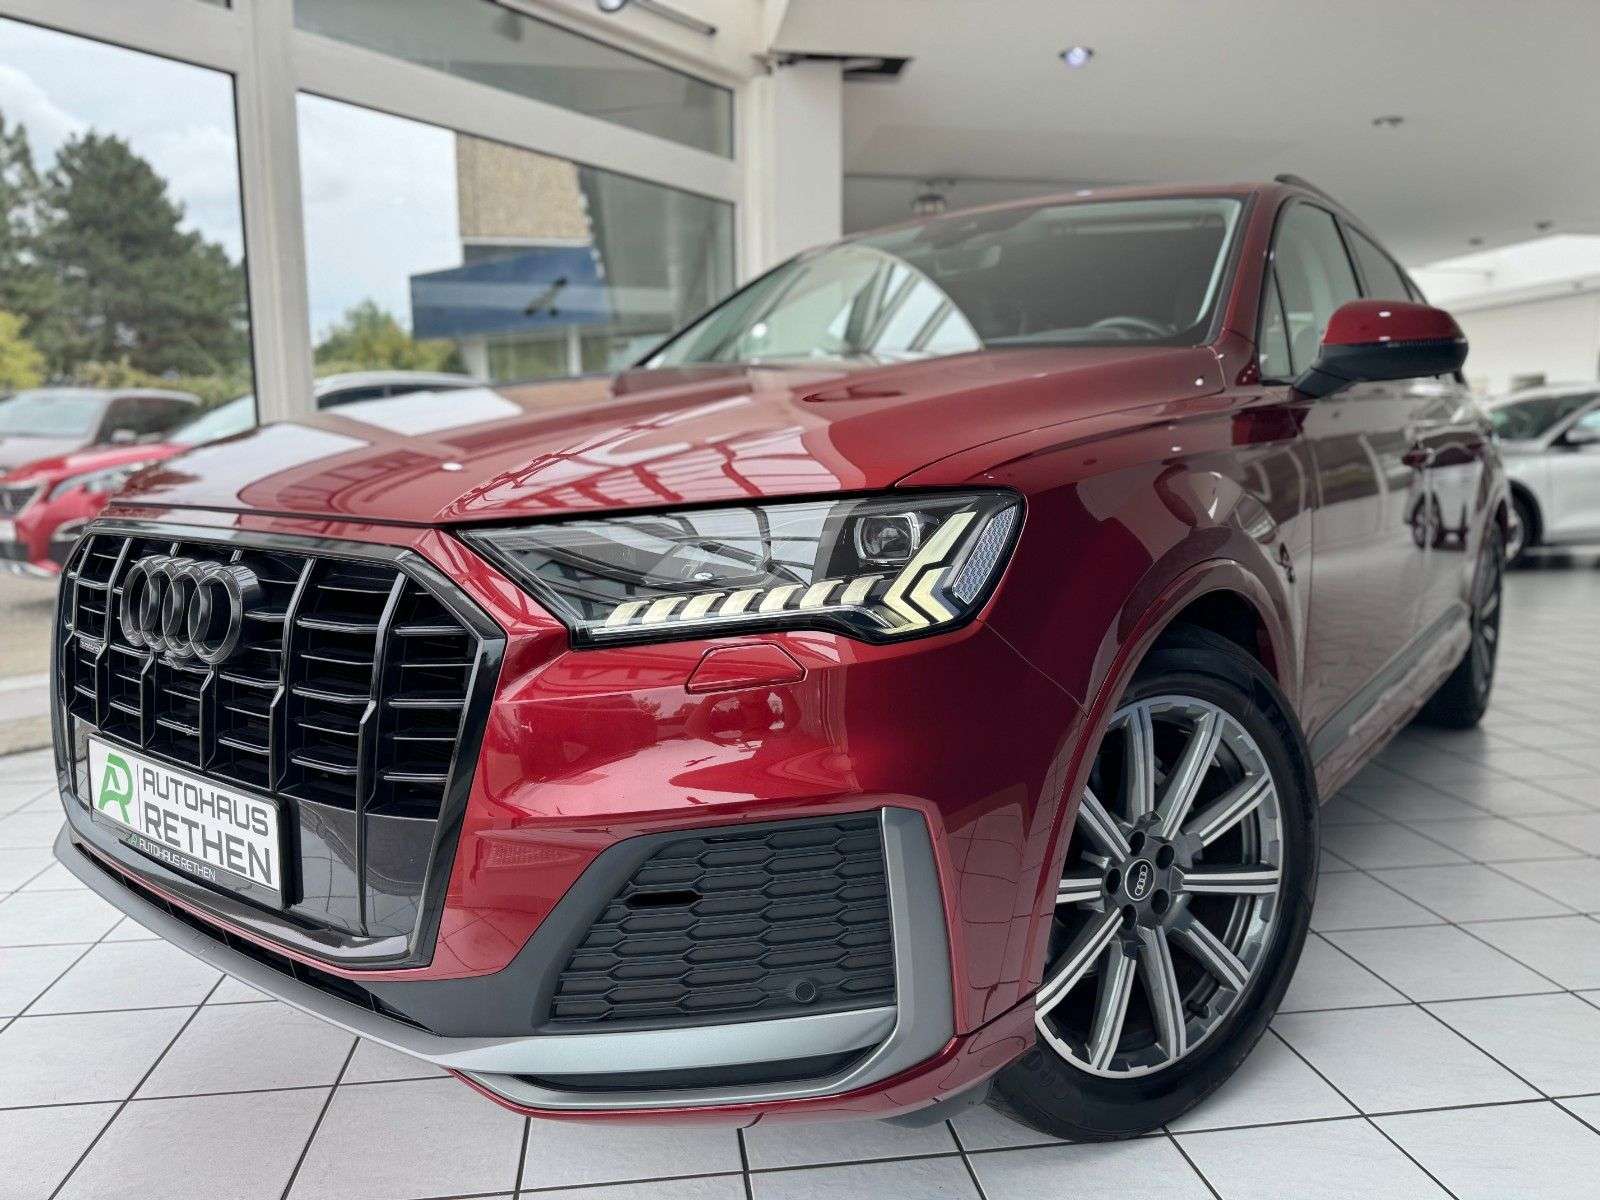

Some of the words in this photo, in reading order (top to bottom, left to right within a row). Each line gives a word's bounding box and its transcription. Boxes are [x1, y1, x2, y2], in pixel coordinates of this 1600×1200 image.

[143, 766, 269, 837] AUTOHAUS
[139, 838, 180, 867] AUTOHAUS
[180, 857, 217, 882] RETHEN
[144, 801, 272, 885] RETHEN
